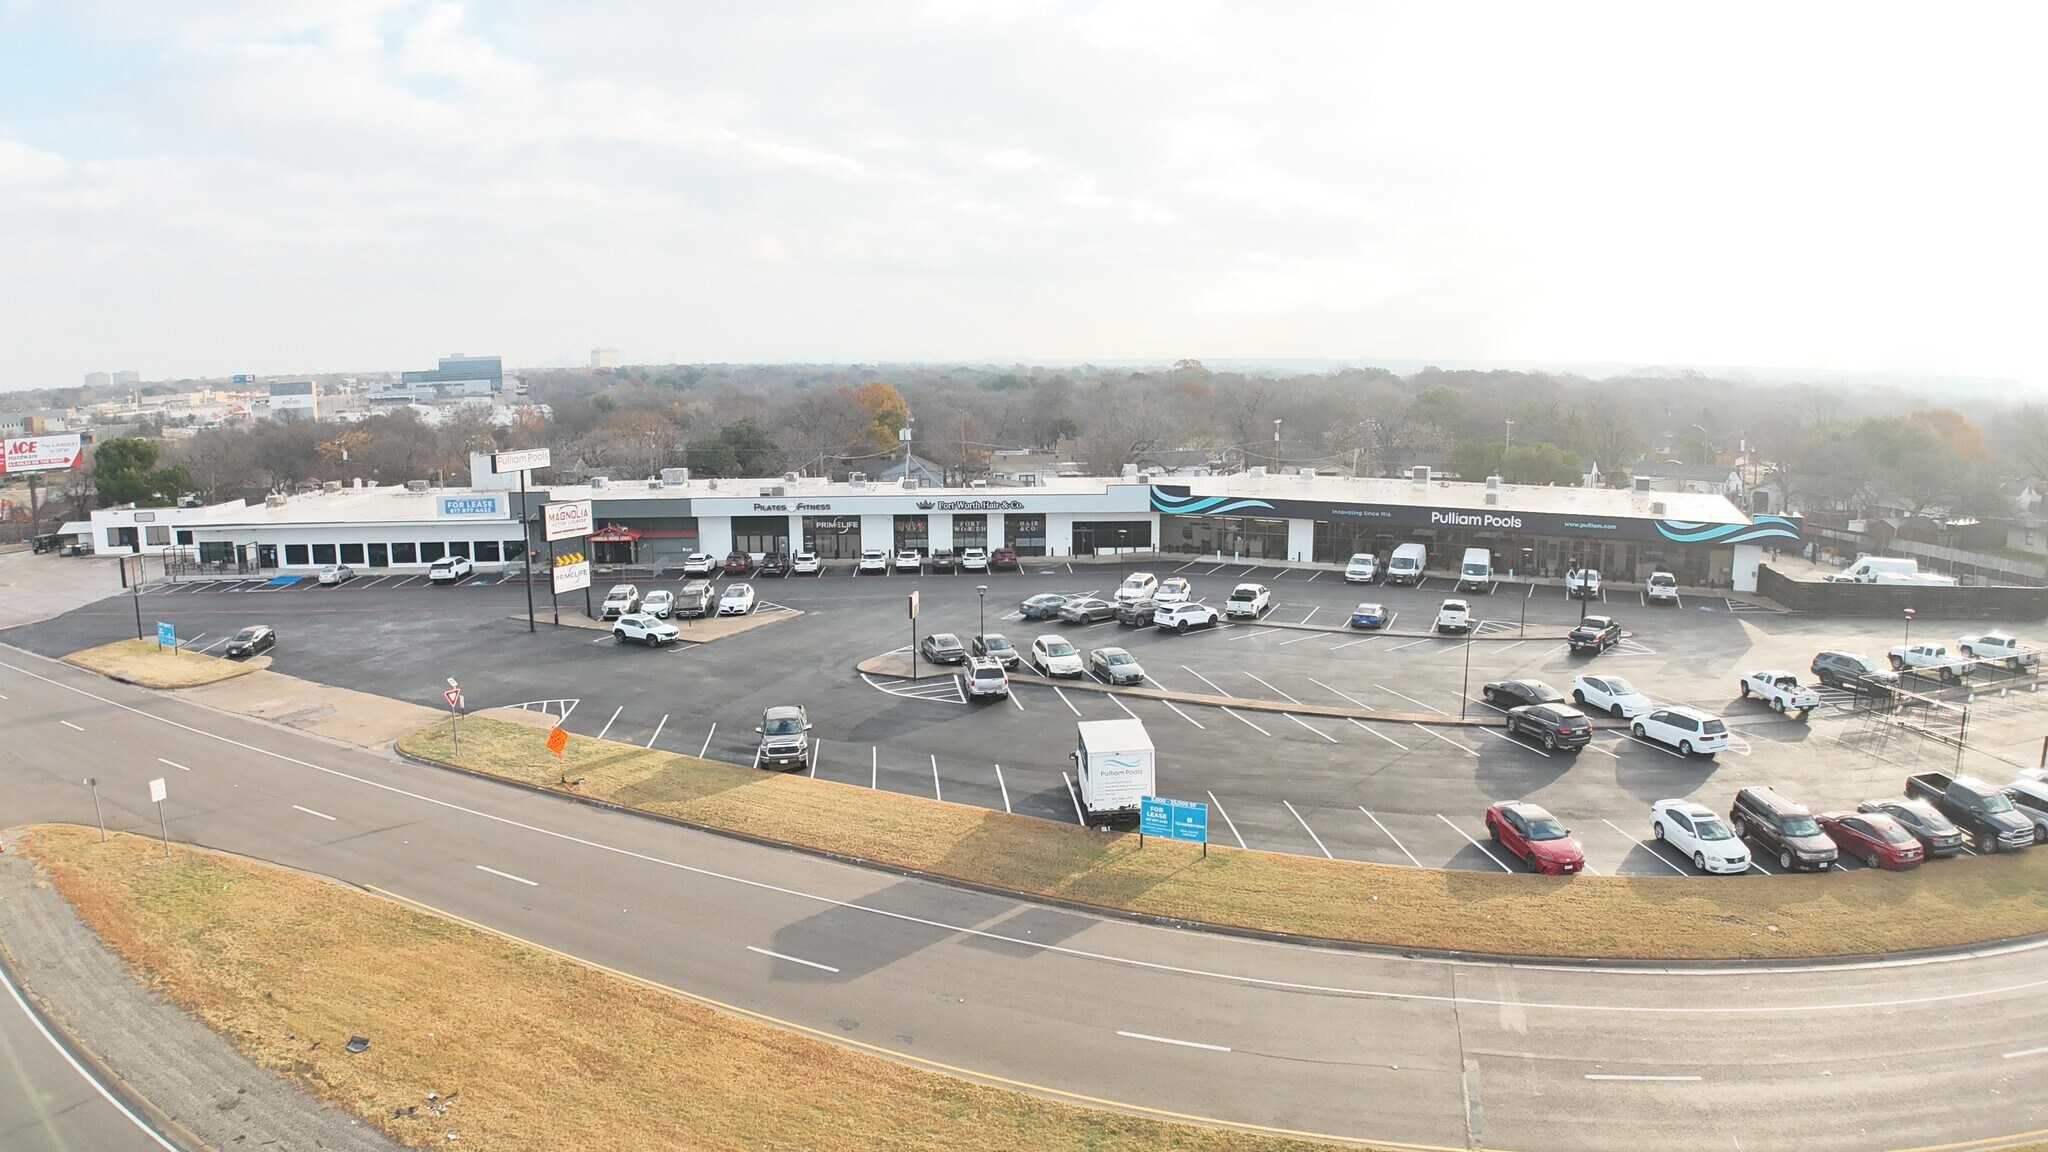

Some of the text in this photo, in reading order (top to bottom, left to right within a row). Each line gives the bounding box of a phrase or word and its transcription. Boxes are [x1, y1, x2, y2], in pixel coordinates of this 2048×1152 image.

[8, 441, 37, 455] ACE
[498, 452, 549, 465] Pulliam Pools
[466, 500, 493, 508] LEASE
[754, 502, 831, 511] PILATES FITNESS
[938, 500, 1025, 510] Fort Worth Hair & Co.
[548, 508, 589, 522] MAGNOLIA
[1332, 509, 1362, 517] Innovating
[1431, 511, 1522, 528] Pulliam Pools
[1564, 522, 1617, 530] www.pulliam.com
[1150, 805, 1164, 813] FOR
[1146, 811, 1167, 820] LEASE
